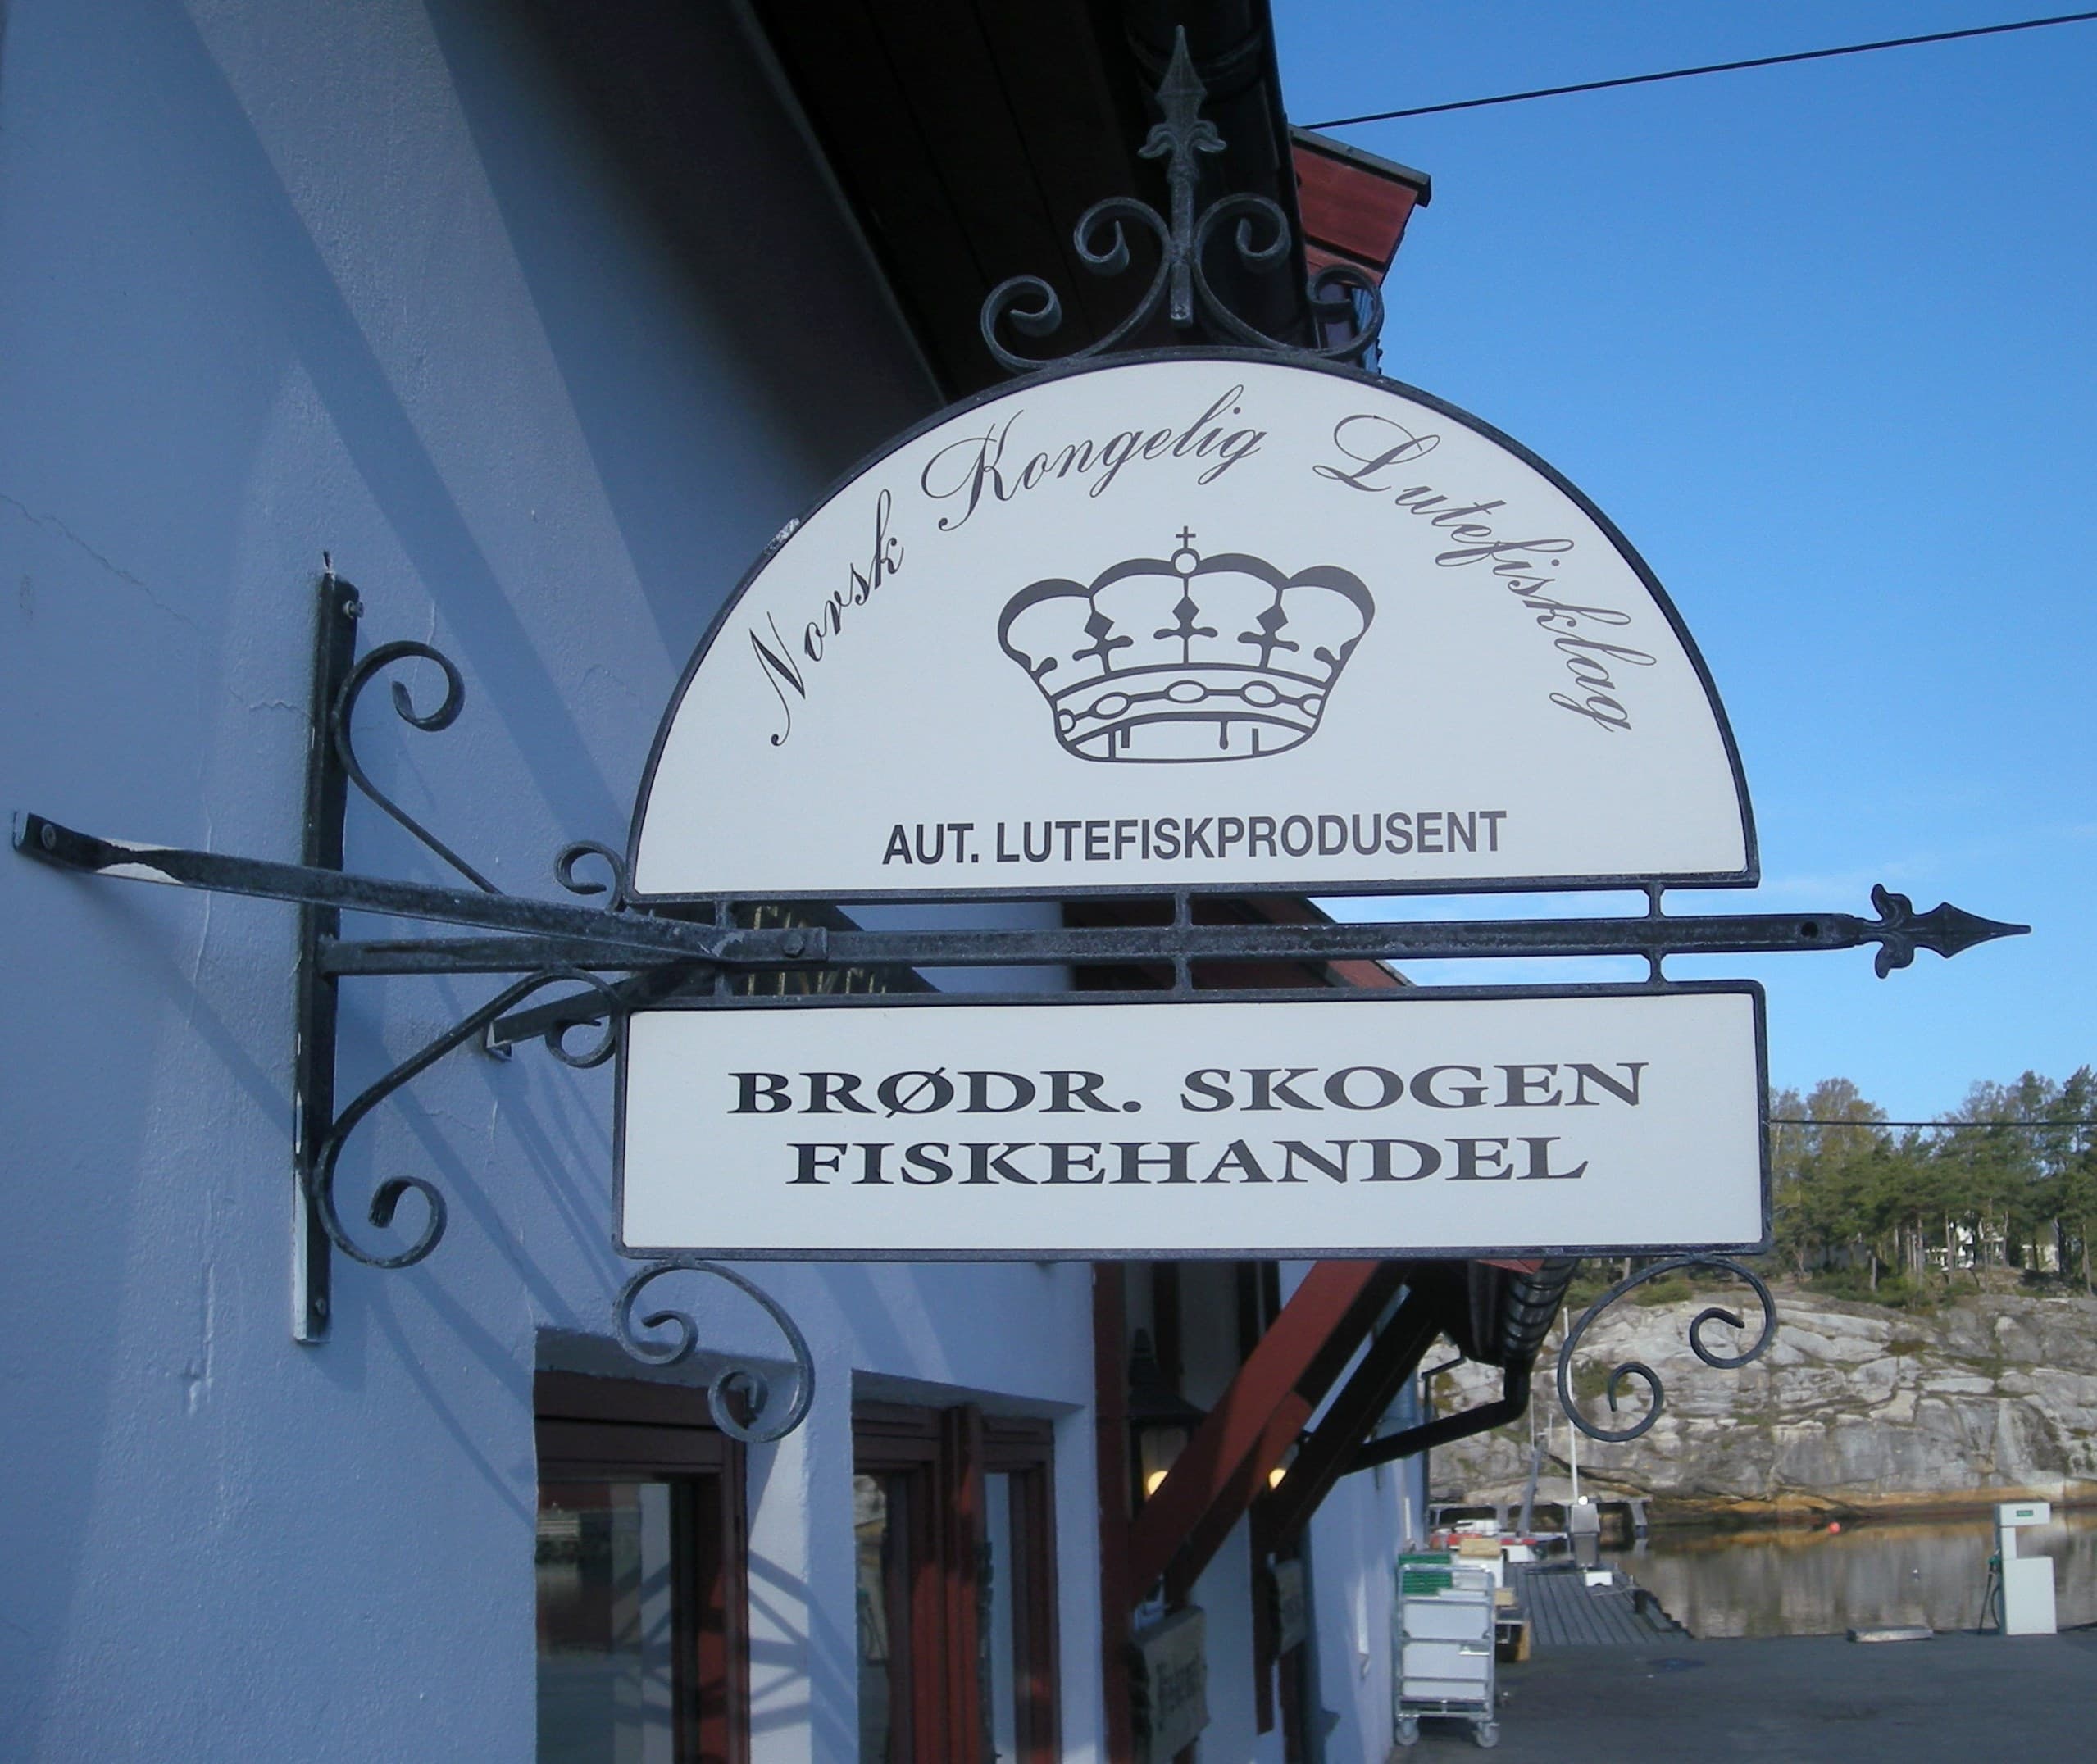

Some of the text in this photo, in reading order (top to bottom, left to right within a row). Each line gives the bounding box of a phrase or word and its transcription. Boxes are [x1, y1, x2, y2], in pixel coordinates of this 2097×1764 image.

[748, 384, 1657, 747] Norsk Kongelig Lutefisklag
[881, 810, 1507, 866] AUT. LUTEFISKPRODUSENT
[726, 1062, 1649, 1119] BRØDR. SKOGEN
[785, 1136, 1589, 1185] FISKEHANDEL
